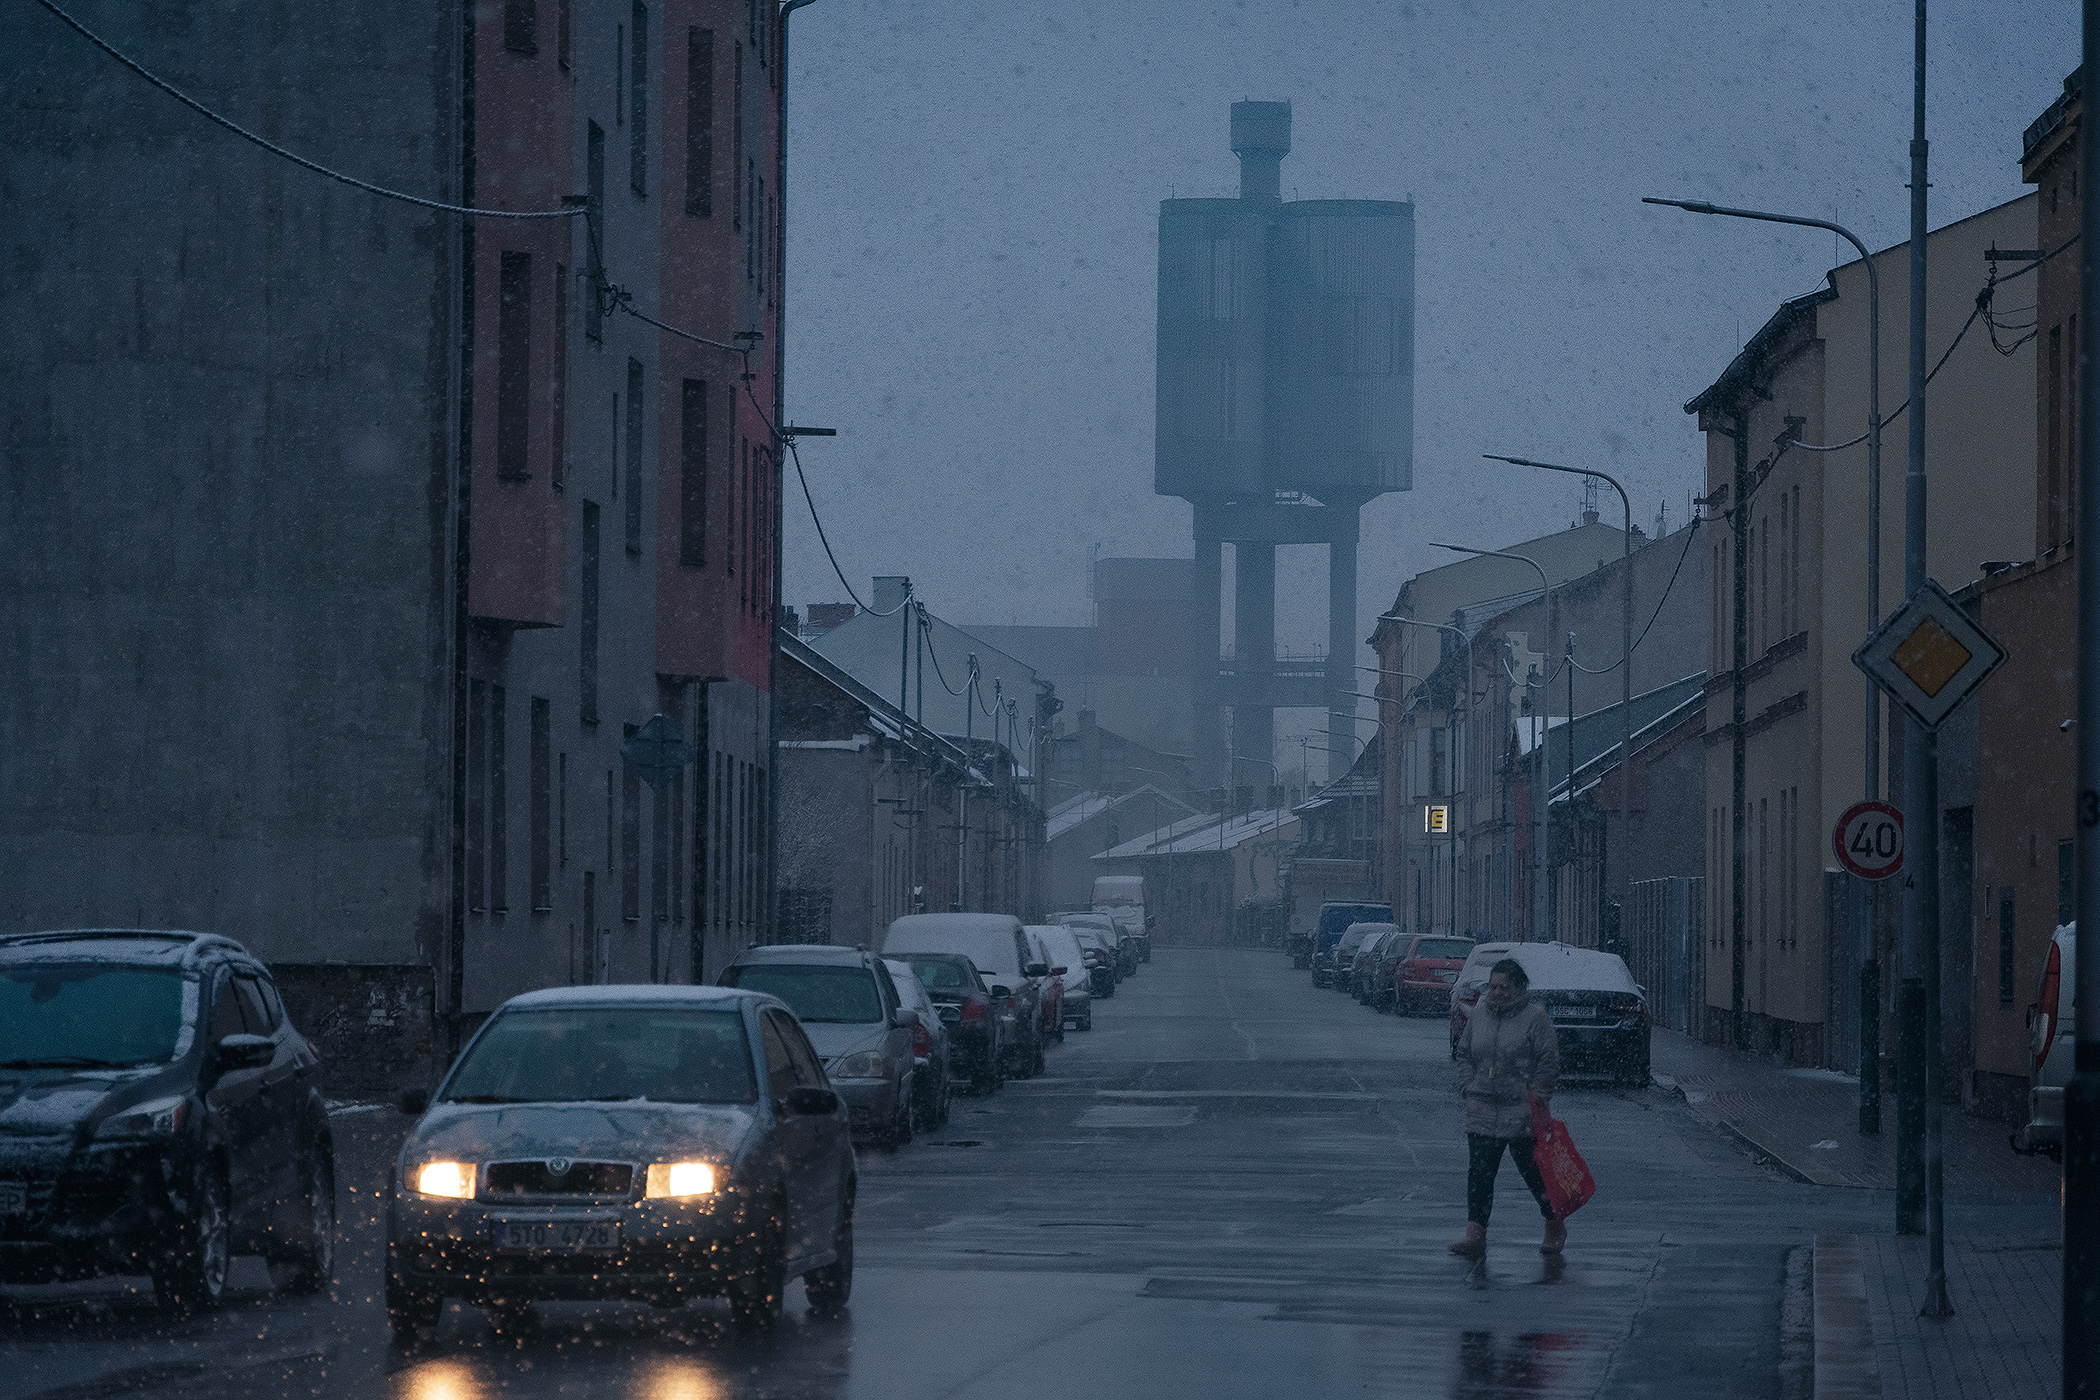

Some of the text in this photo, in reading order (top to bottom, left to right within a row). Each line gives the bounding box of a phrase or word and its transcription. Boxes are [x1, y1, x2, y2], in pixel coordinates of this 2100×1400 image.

[2082, 790, 2099, 828] 3
[1851, 822, 1897, 858] 40
[1905, 874, 1915, 889] 4
[561, 1225, 609, 1245] 4728
